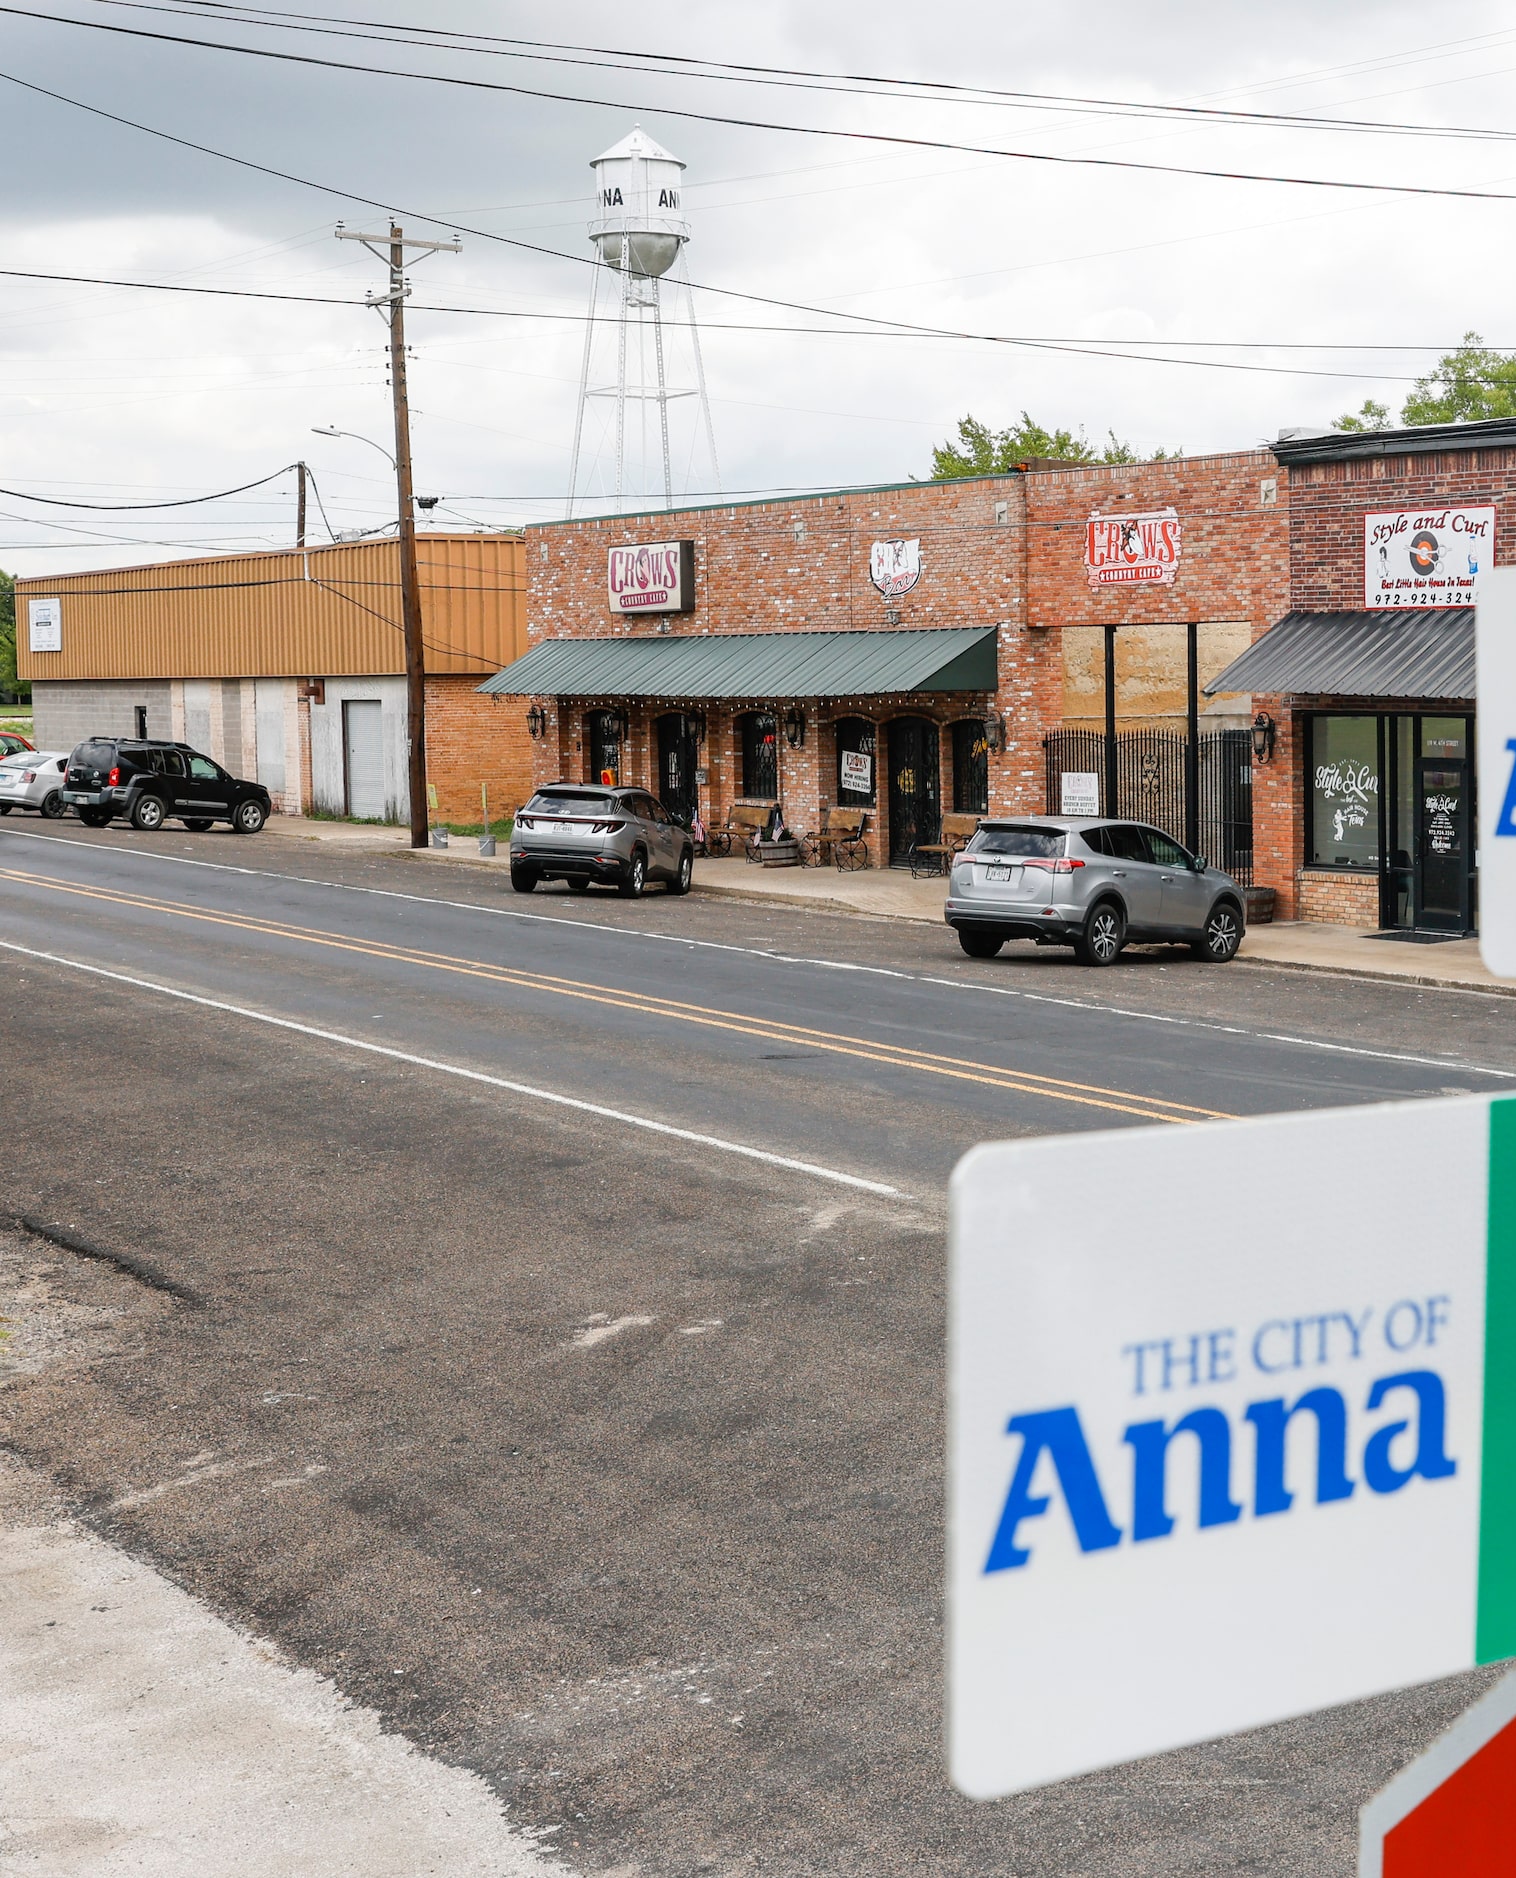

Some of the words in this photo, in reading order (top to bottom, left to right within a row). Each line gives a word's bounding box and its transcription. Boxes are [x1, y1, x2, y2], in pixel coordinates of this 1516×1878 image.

[596, 188, 623, 208] NA
[1370, 514, 1408, 545] Style
[1413, 511, 1450, 530] and
[1452, 514, 1488, 537] Curl
[1381, 579, 1394, 590] Best
[1395, 578, 1412, 589] Little
[1414, 578, 1427, 589] Hair
[1429, 577, 1446, 589] House
[1447, 576, 1455, 587] In
[1375, 592, 1478, 605] 972-924-324
[1314, 763, 1343, 799] Style
[1357, 765, 1379, 795] Cur
[1347, 813, 1365, 828] Texas
[1122, 1328, 1236, 1396] THE
[1251, 1307, 1374, 1374] CITY
[1383, 1294, 1451, 1354] OF
[982, 1368, 1459, 1577] Anna
